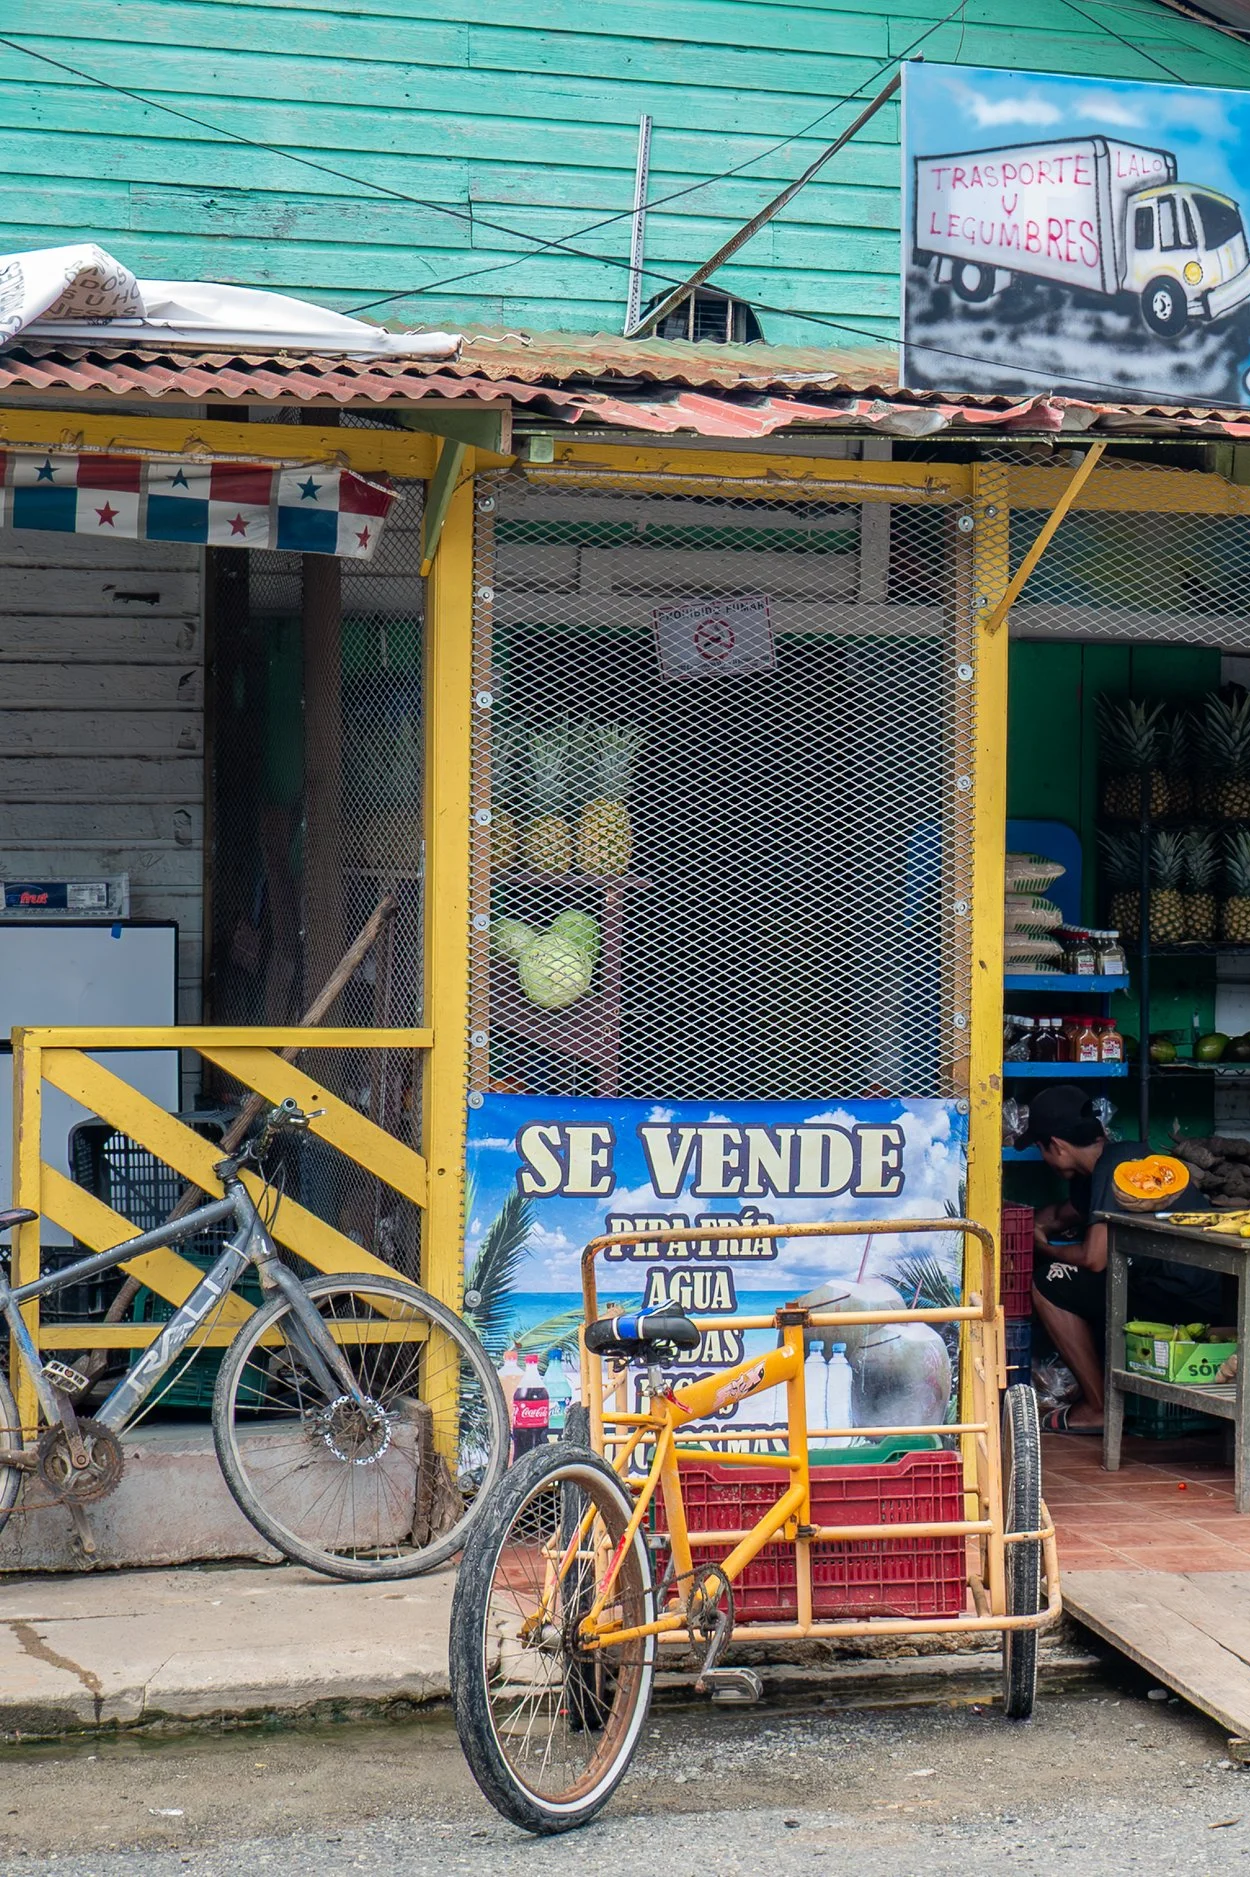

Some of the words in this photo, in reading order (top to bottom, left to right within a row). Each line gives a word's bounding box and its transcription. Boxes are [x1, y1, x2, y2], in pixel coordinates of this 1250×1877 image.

[930, 153, 1093, 192] TRASPORTE
[1115, 151, 1163, 178] LALO
[929, 211, 1100, 269] LEGUMBRES
[518, 1122, 615, 1197] SE
[639, 1122, 904, 1198] VENDE
[646, 1268, 735, 1311] AGUA
